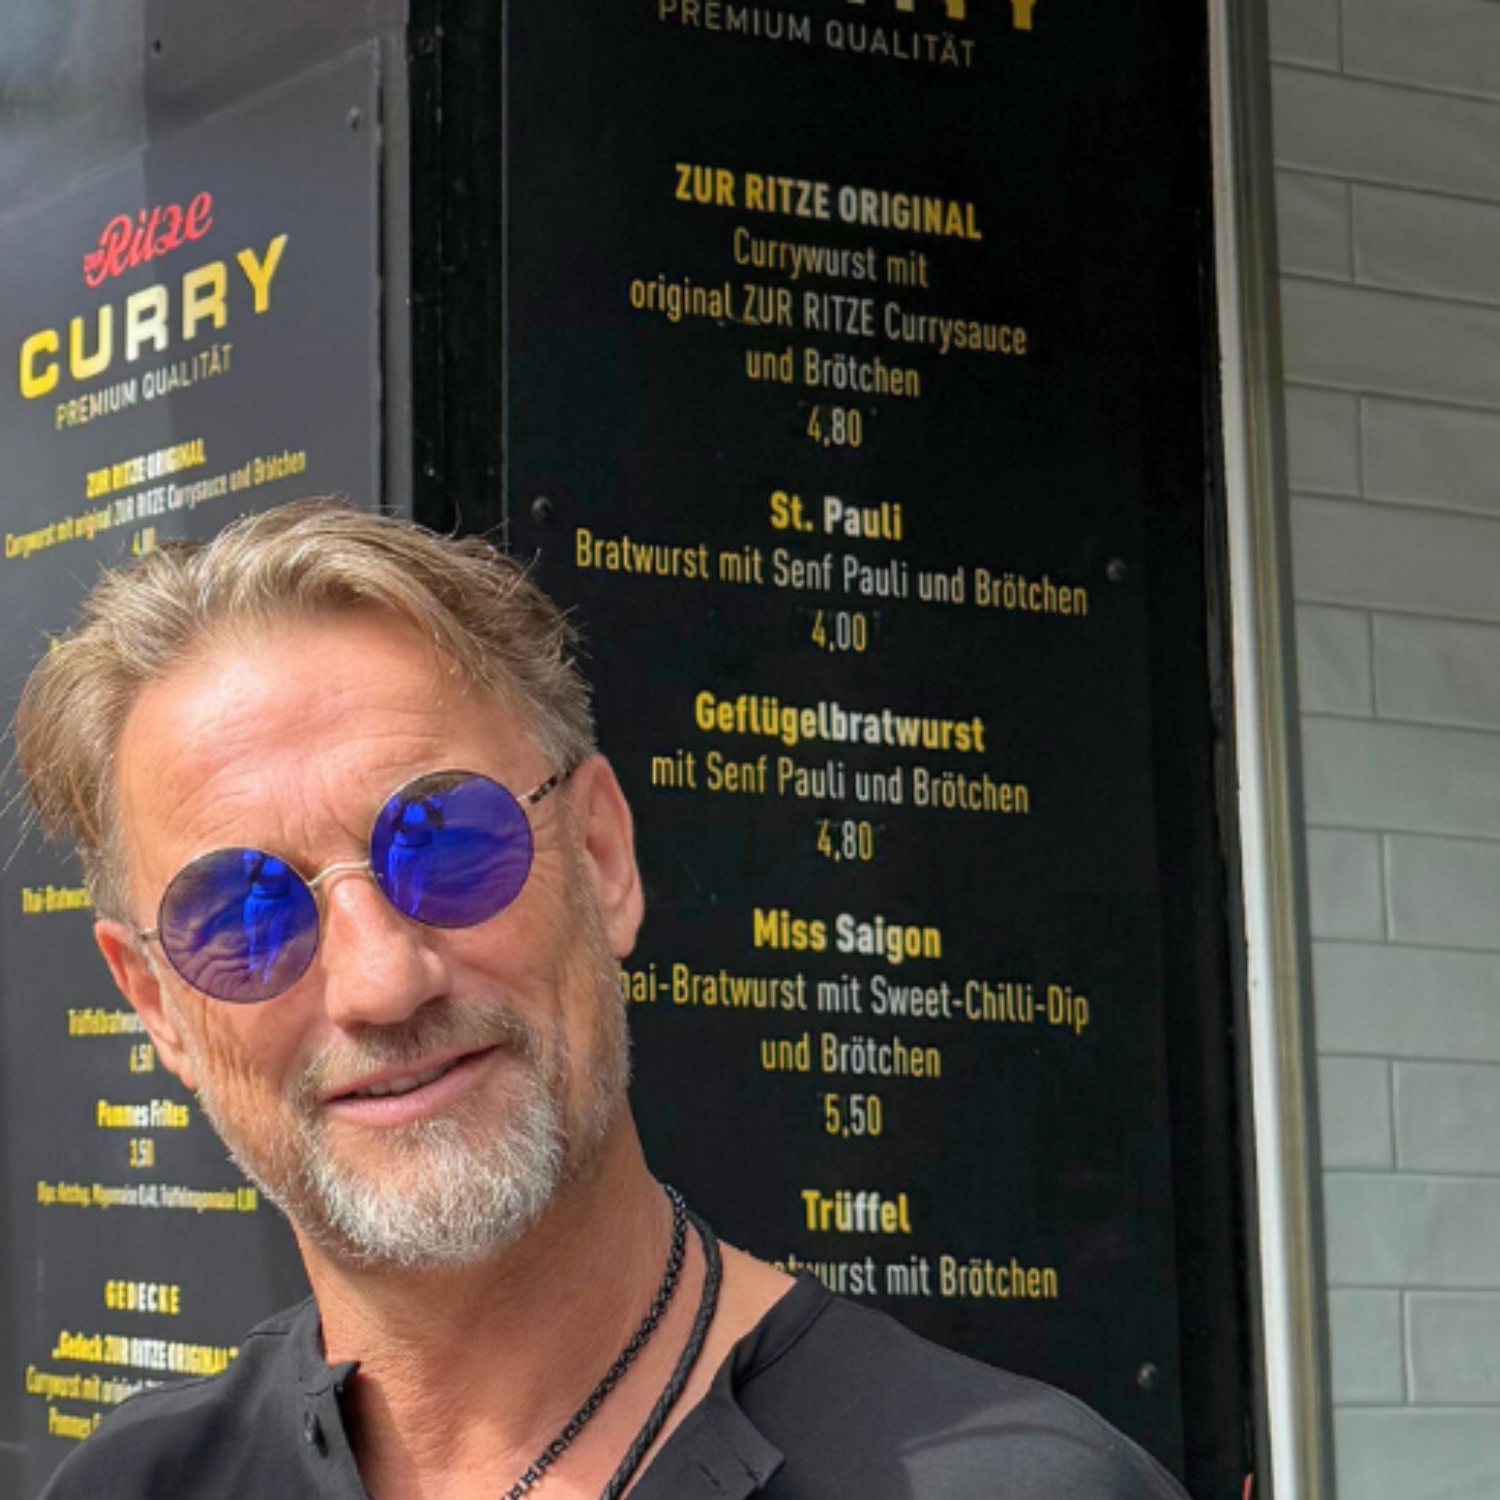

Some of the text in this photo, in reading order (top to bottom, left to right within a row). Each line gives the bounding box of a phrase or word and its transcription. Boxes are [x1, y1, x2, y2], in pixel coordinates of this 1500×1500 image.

[658, 0, 812, 44] PREMIUM
[826, 19, 977, 68] QUALITÄT
[675, 162, 982, 240] ZUR RITZE ORIGINAL
[733, 227, 930, 289] Currywurst mit
[18, 233, 289, 400] CURRY
[629, 274, 1029, 356] original ZUR RITZE Currysauce
[55, 343, 233, 430] PREMIUM QUALITÄT
[746, 345, 921, 398] und Brötchen
[806, 407, 864, 448] 4,80
[770, 489, 904, 542] St. Pauli
[575, 527, 1090, 618] Bratwurst mit Senf Pauli und Brötchen
[811, 609, 867, 653] 4,00
[695, 691, 987, 754] Geflügelbratwurst
[651, 748, 1031, 815] mit Senf Pauli und Brötchen
[816, 818, 874, 862] 4,80
[753, 907, 942, 965] Miss Saigon
[817, 973, 863, 1015] mit
[870, 973, 1091, 1036] Sweet-Chilli-Dip
[761, 1032, 942, 1079] und Brötchen
[824, 1092, 883, 1138] 5,50
[801, 1188, 912, 1234] Trüffel
[105, 1278, 182, 1317] GEDECKE
[887, 1254, 932, 1297] mit
[939, 1255, 1059, 1299] Brötchen
